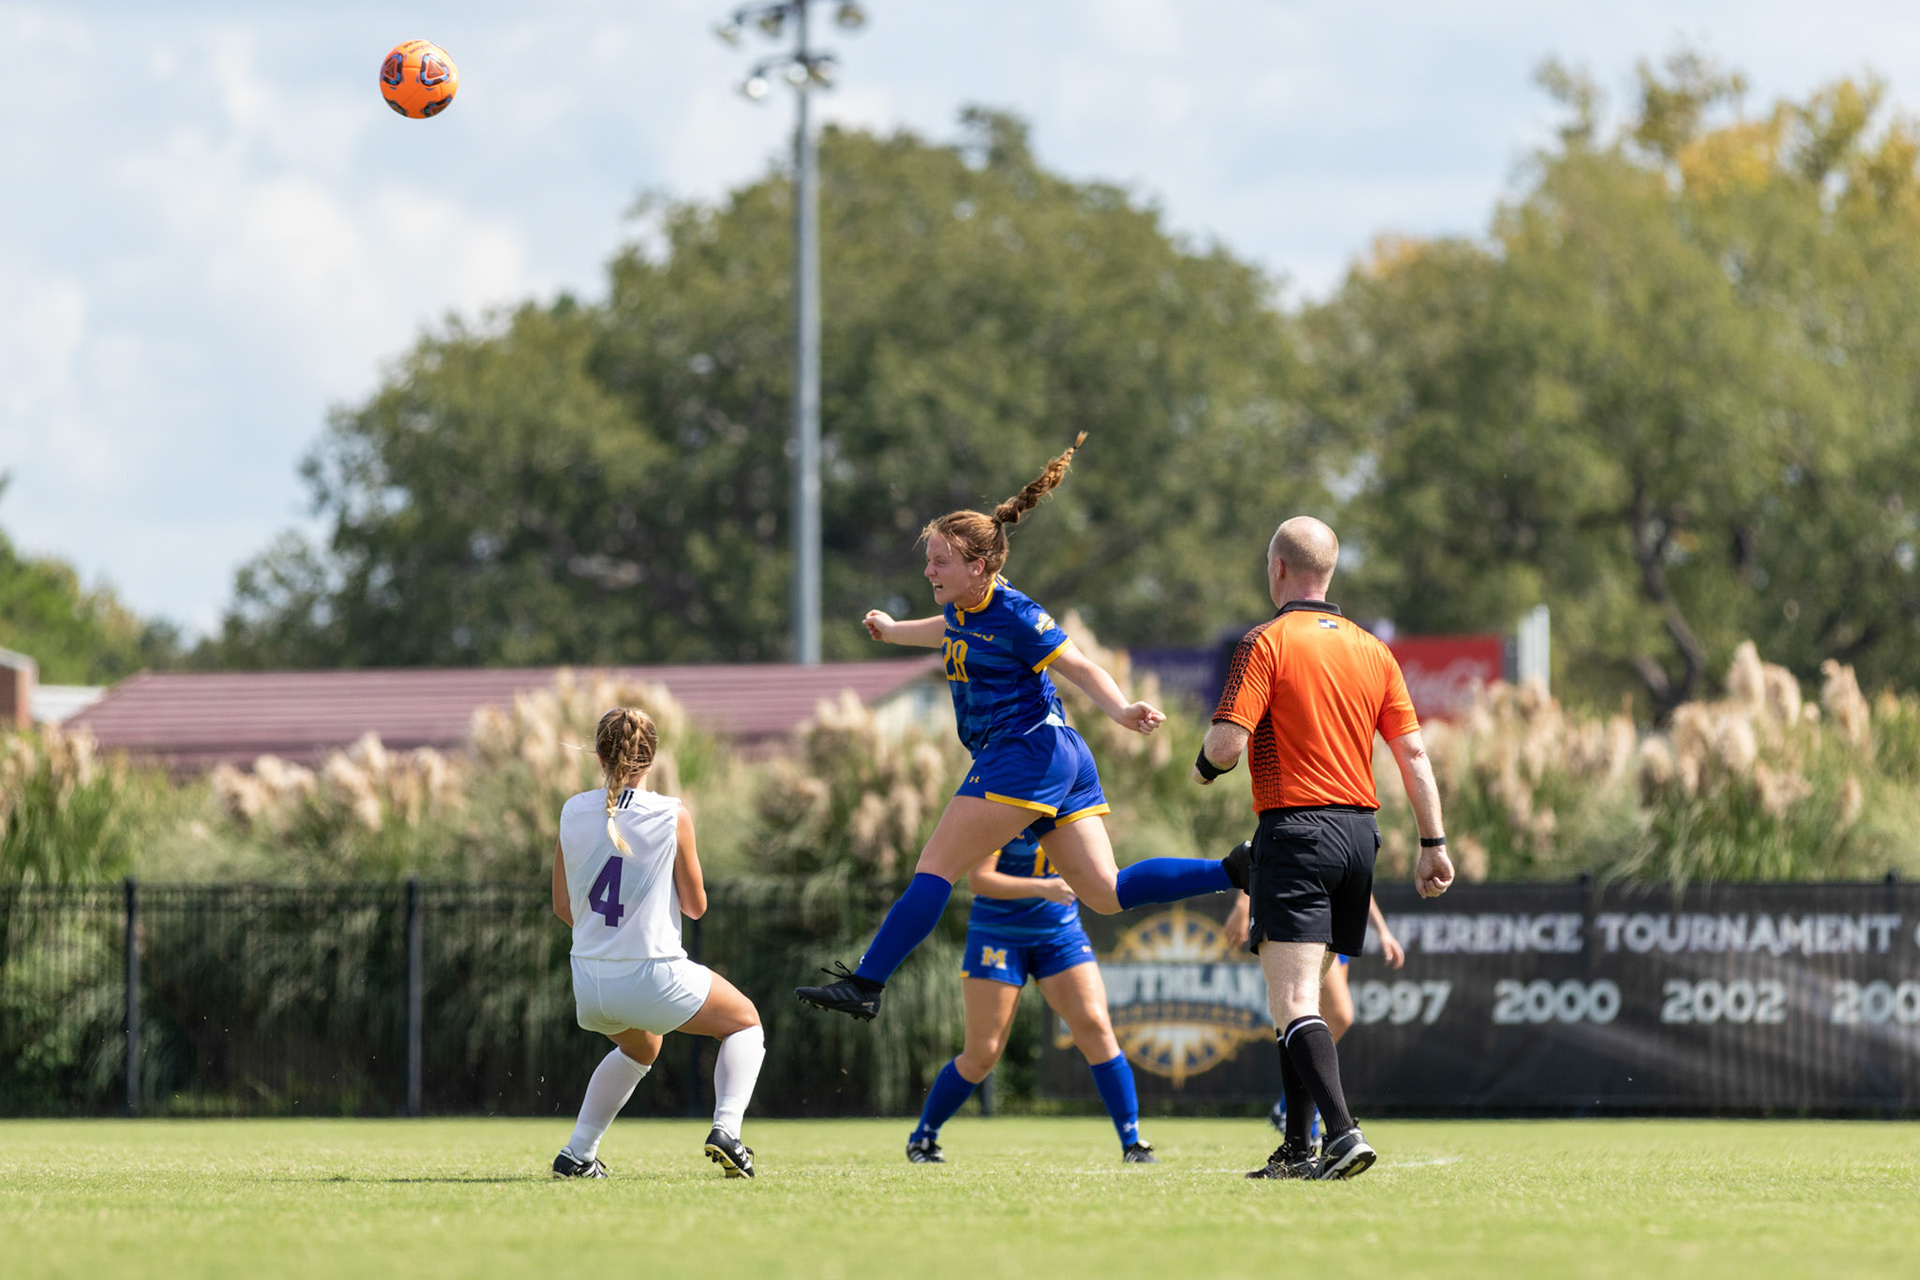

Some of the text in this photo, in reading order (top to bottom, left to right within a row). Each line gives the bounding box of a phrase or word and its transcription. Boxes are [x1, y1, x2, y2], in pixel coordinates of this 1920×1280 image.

[942, 637, 969, 682] 28
[588, 855, 624, 928] 4
[1595, 912, 1902, 955] TOURNAMENT
[981, 945, 1008, 970] M
[1350, 979, 1920, 1025] 1997 2000 2002 200
